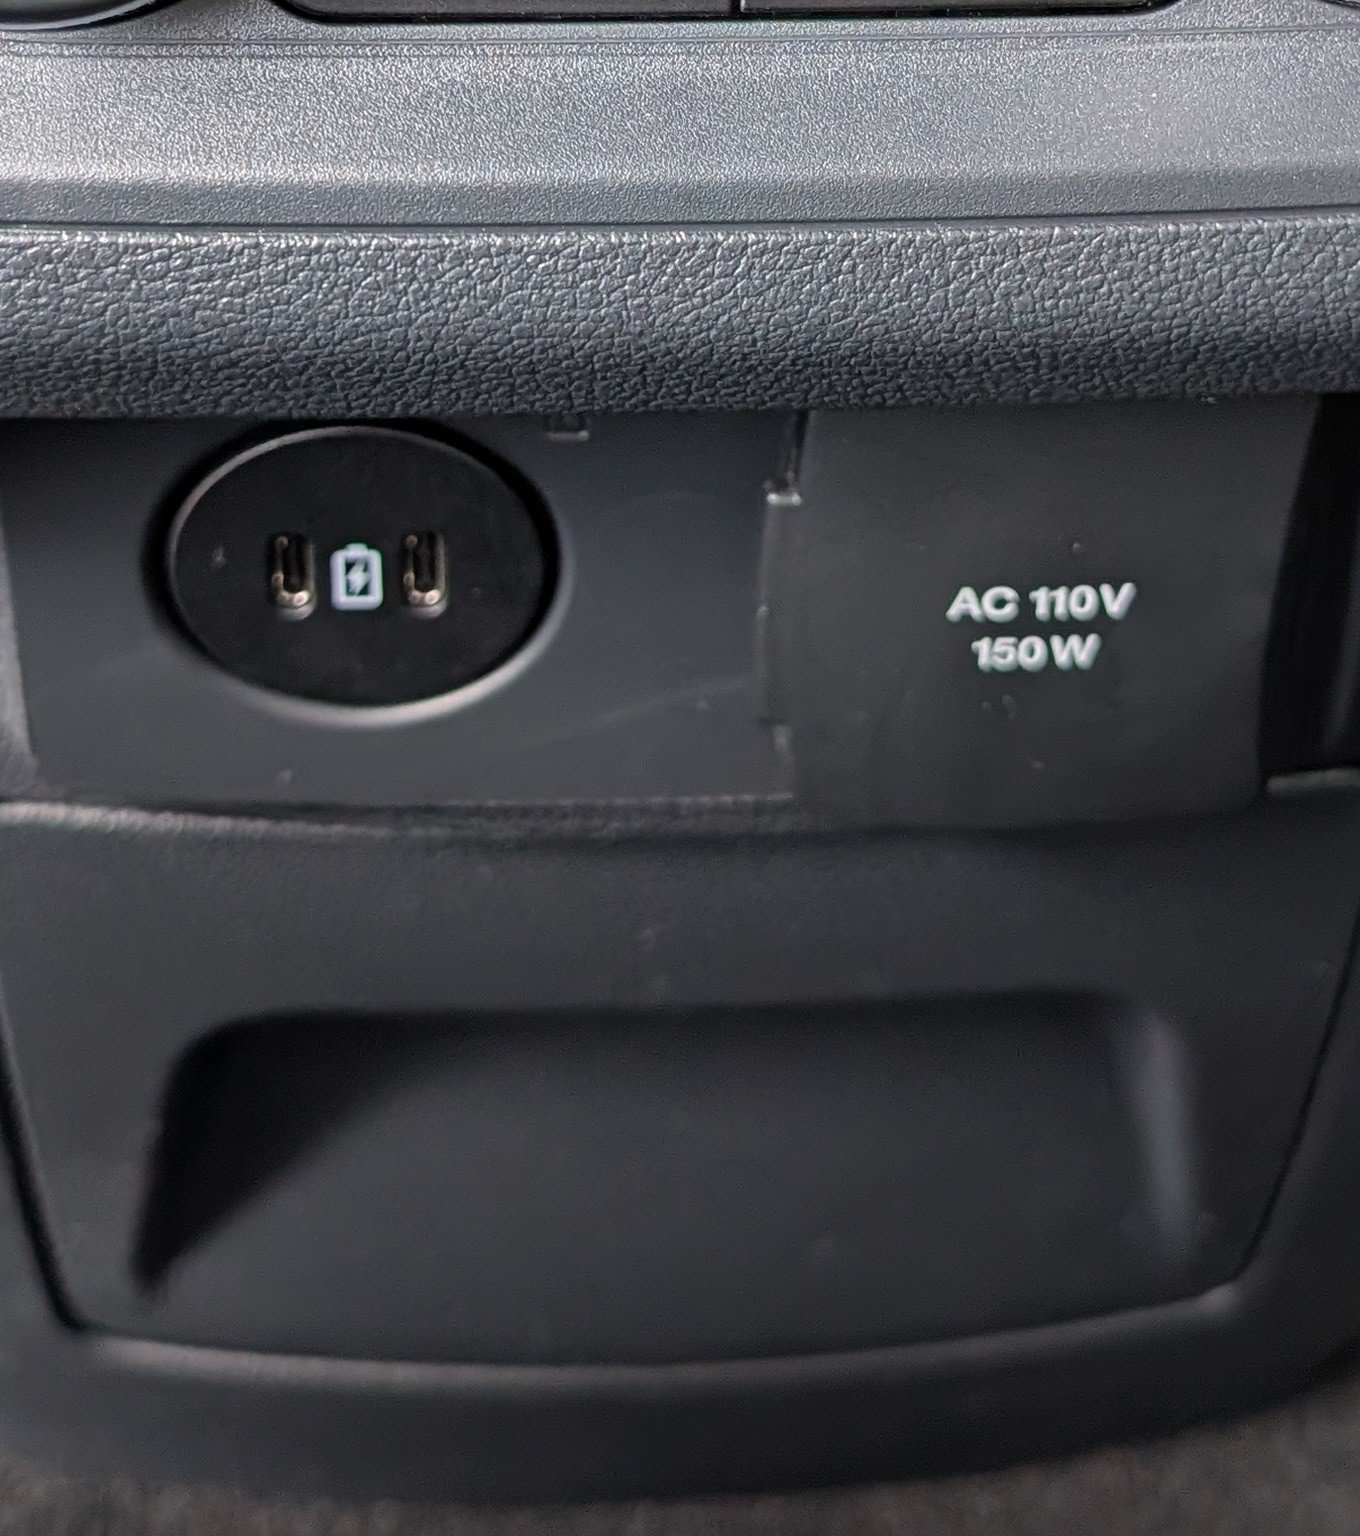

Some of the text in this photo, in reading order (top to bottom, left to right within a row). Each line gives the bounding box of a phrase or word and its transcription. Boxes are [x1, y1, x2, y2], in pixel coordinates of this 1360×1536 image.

[944, 581, 1138, 623] AC 110V
[970, 632, 1103, 674] 150W
